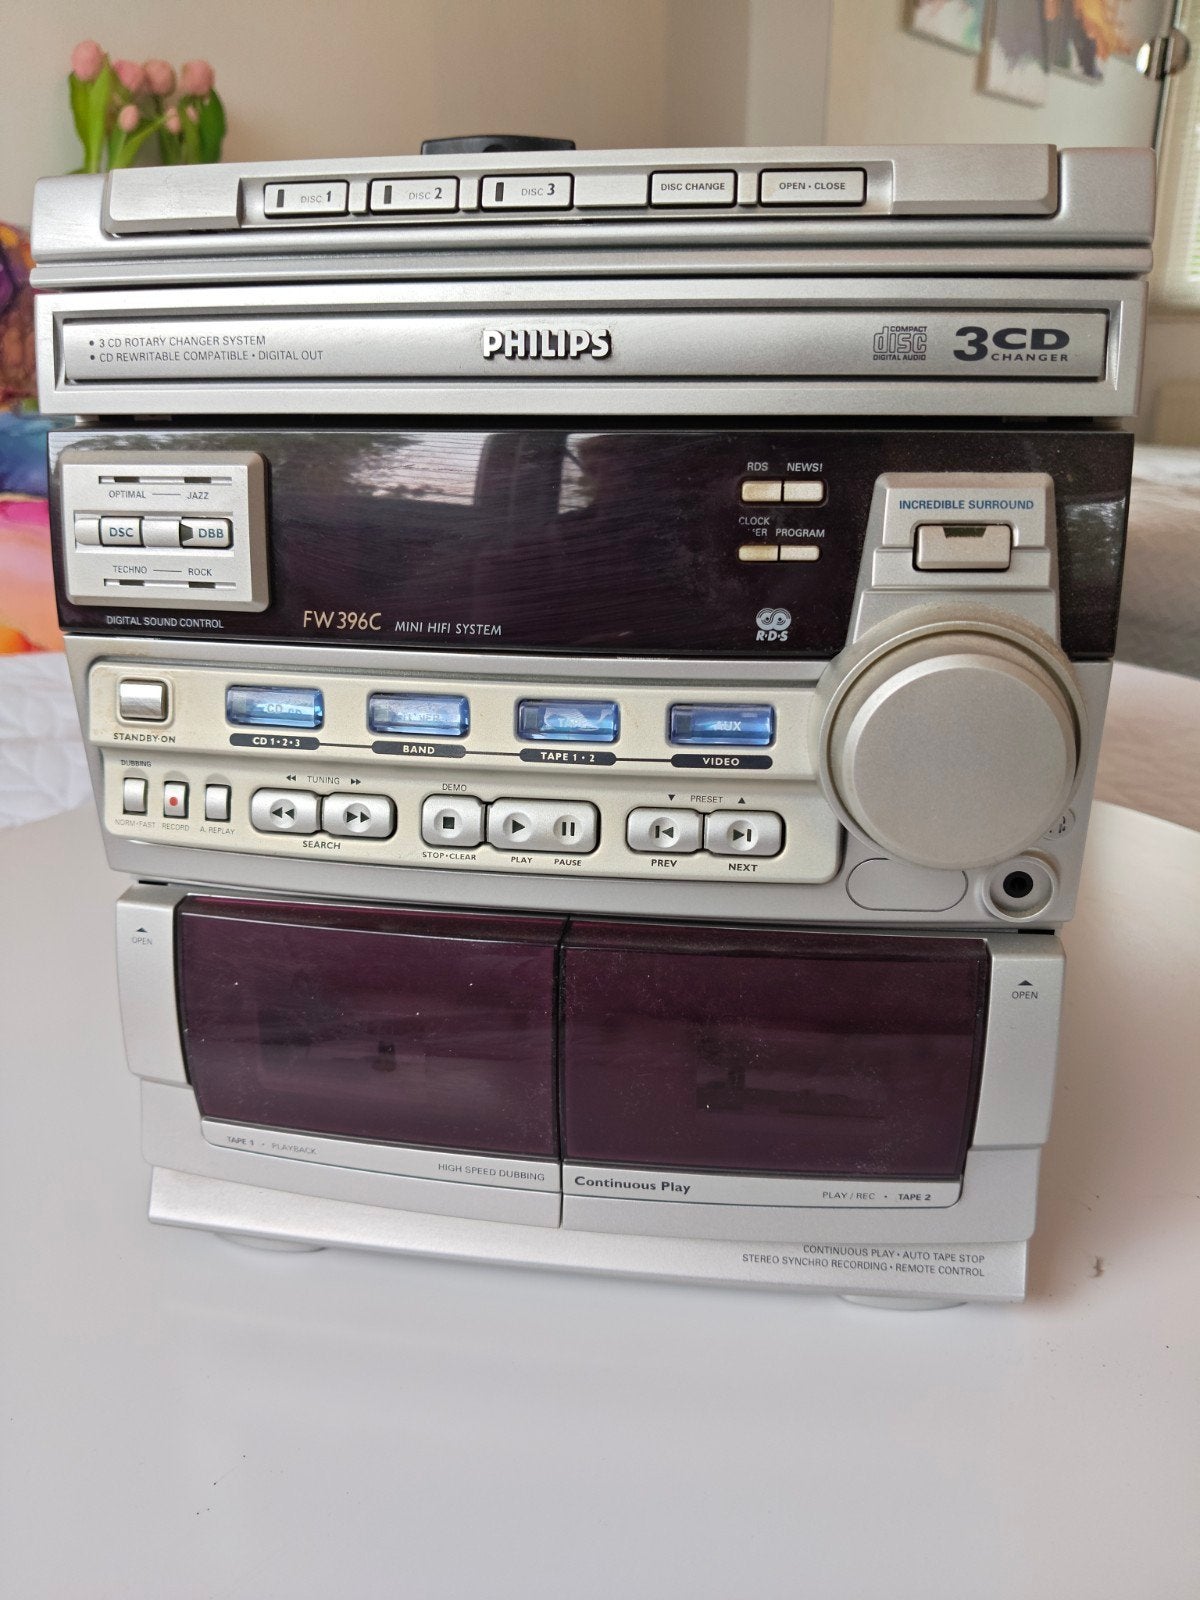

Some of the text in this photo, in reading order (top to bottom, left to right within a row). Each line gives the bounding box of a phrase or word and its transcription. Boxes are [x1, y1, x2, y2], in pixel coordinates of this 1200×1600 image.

[521, 183, 556, 197] DISC 3
[660, 182, 726, 191] DISC CHANGE
[779, 182, 846, 190] OPEN CLOSE
[300, 190, 332, 204] DISC 1
[408, 187, 443, 200] DISC 2
[99, 335, 266, 348] 3 CD ROTARY CHANGER SYSTEM
[482, 329, 612, 359] PHILIPS
[99, 350, 324, 363] CD REWRITABLE COMPATIBLE DIGITAL OUT
[991, 354, 1069, 362] CHANGER
[747, 462, 823, 472] RDS NEWS!
[108, 490, 209, 500] OPTIMAL JAZZ
[899, 500, 1034, 510] INCREDIBLE SURROUND
[738, 516, 770, 526] CLOCK
[109, 527, 134, 537] DSC
[198, 528, 224, 538] DBB
[775, 528, 825, 538] PROGRAM
[112, 566, 212, 576] TECHNO ROCK
[106, 616, 224, 629] DIGITAL SOUND CONTROL
[394, 621, 423, 633] MINI
[428, 622, 451, 634] HIFI
[456, 624, 502, 636] SYSTEM
[252, 736, 268, 746] CD
[402, 744, 435, 755] BAND
[540, 752, 569, 762] TAPE
[702, 757, 740, 766] VIDEO
[120, 759, 152, 768] DUBBING
[307, 776, 340, 785] TUNING
[442, 783, 467, 792] DEMO
[690, 795, 724, 804] PRESET
[162, 822, 190, 832] RECORD
[208, 826, 236, 836] REPLAY
[302, 840, 341, 850] SEARCH
[510, 856, 533, 865] PLAY
[554, 858, 582, 868] PAUSE
[651, 859, 678, 868] PREV
[728, 863, 758, 872] NEXT
[131, 936, 153, 946] OPEN
[1011, 990, 1039, 1000] OPEN
[226, 1136, 247, 1145] TAPE
[272, 1142, 317, 1155] PLAYBACK
[438, 1163, 545, 1182] HIGH SPEED DUBBING
[574, 1176, 692, 1195] Continuous Play
[898, 1193, 922, 1201] TAPE
[924, 1193, 931, 1201] 2
[803, 1244, 985, 1264] CONTINUOUS PLAY AUTO TAPE STOP
[742, 1253, 985, 1278] STEREO SYNCHRO RECORDING REMOTE CONTROL
